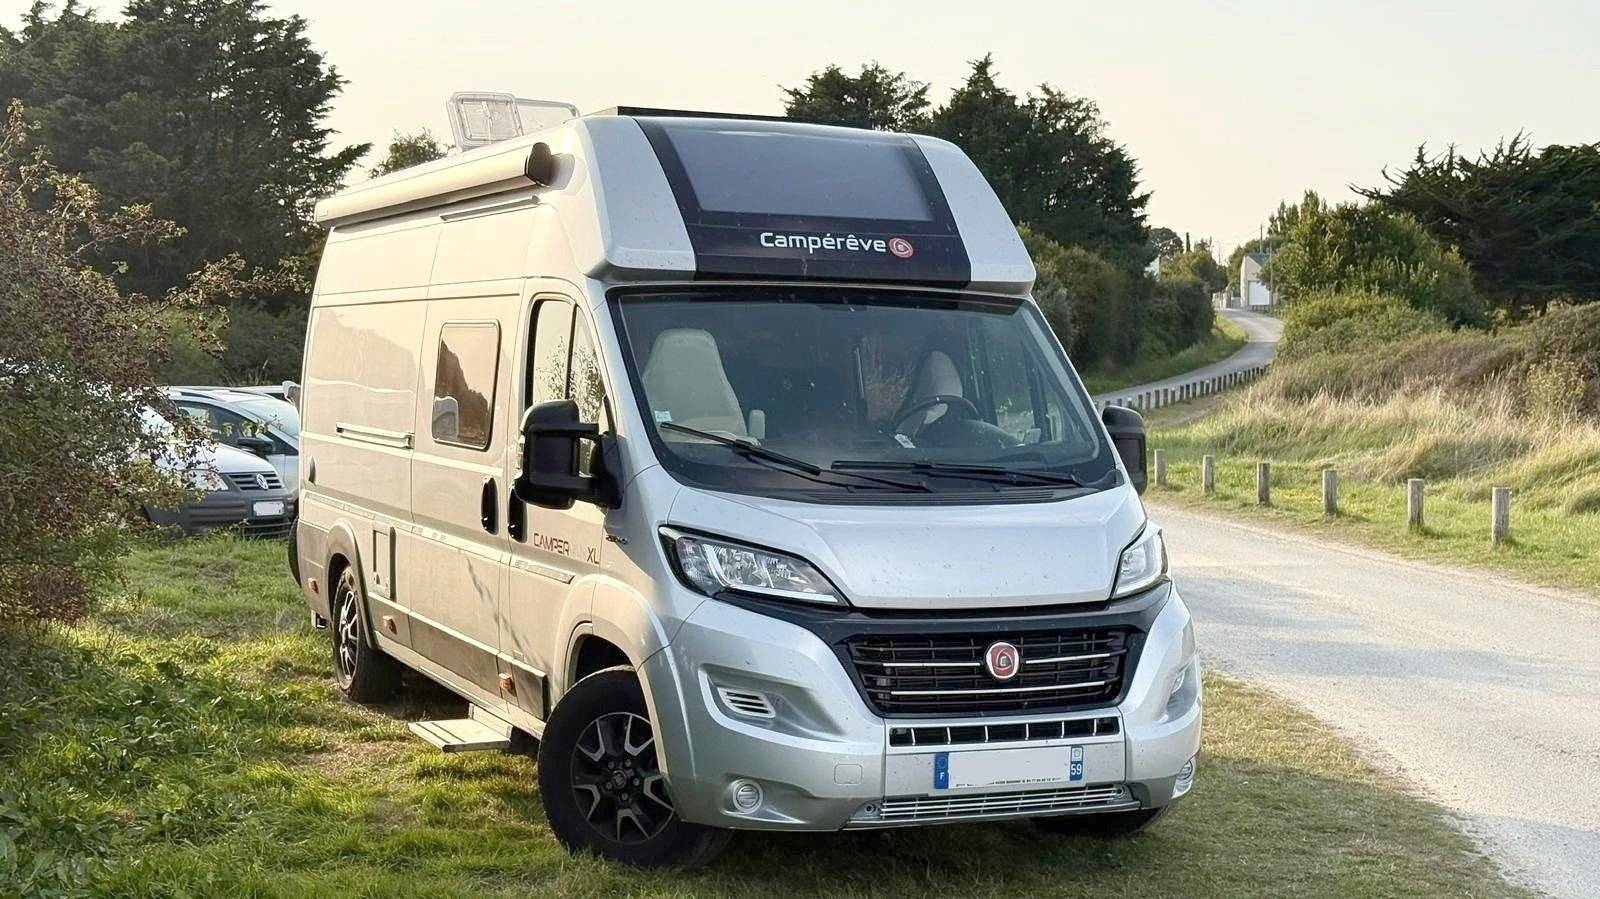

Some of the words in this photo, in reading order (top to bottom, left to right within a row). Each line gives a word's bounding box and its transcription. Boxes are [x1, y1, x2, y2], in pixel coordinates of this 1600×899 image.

[760, 232, 887, 254] Campérêve
[533, 532, 570, 556] CAMPER
[586, 546, 600, 565] XL
[939, 772, 945, 780] F
[1070, 764, 1082, 775] 59
